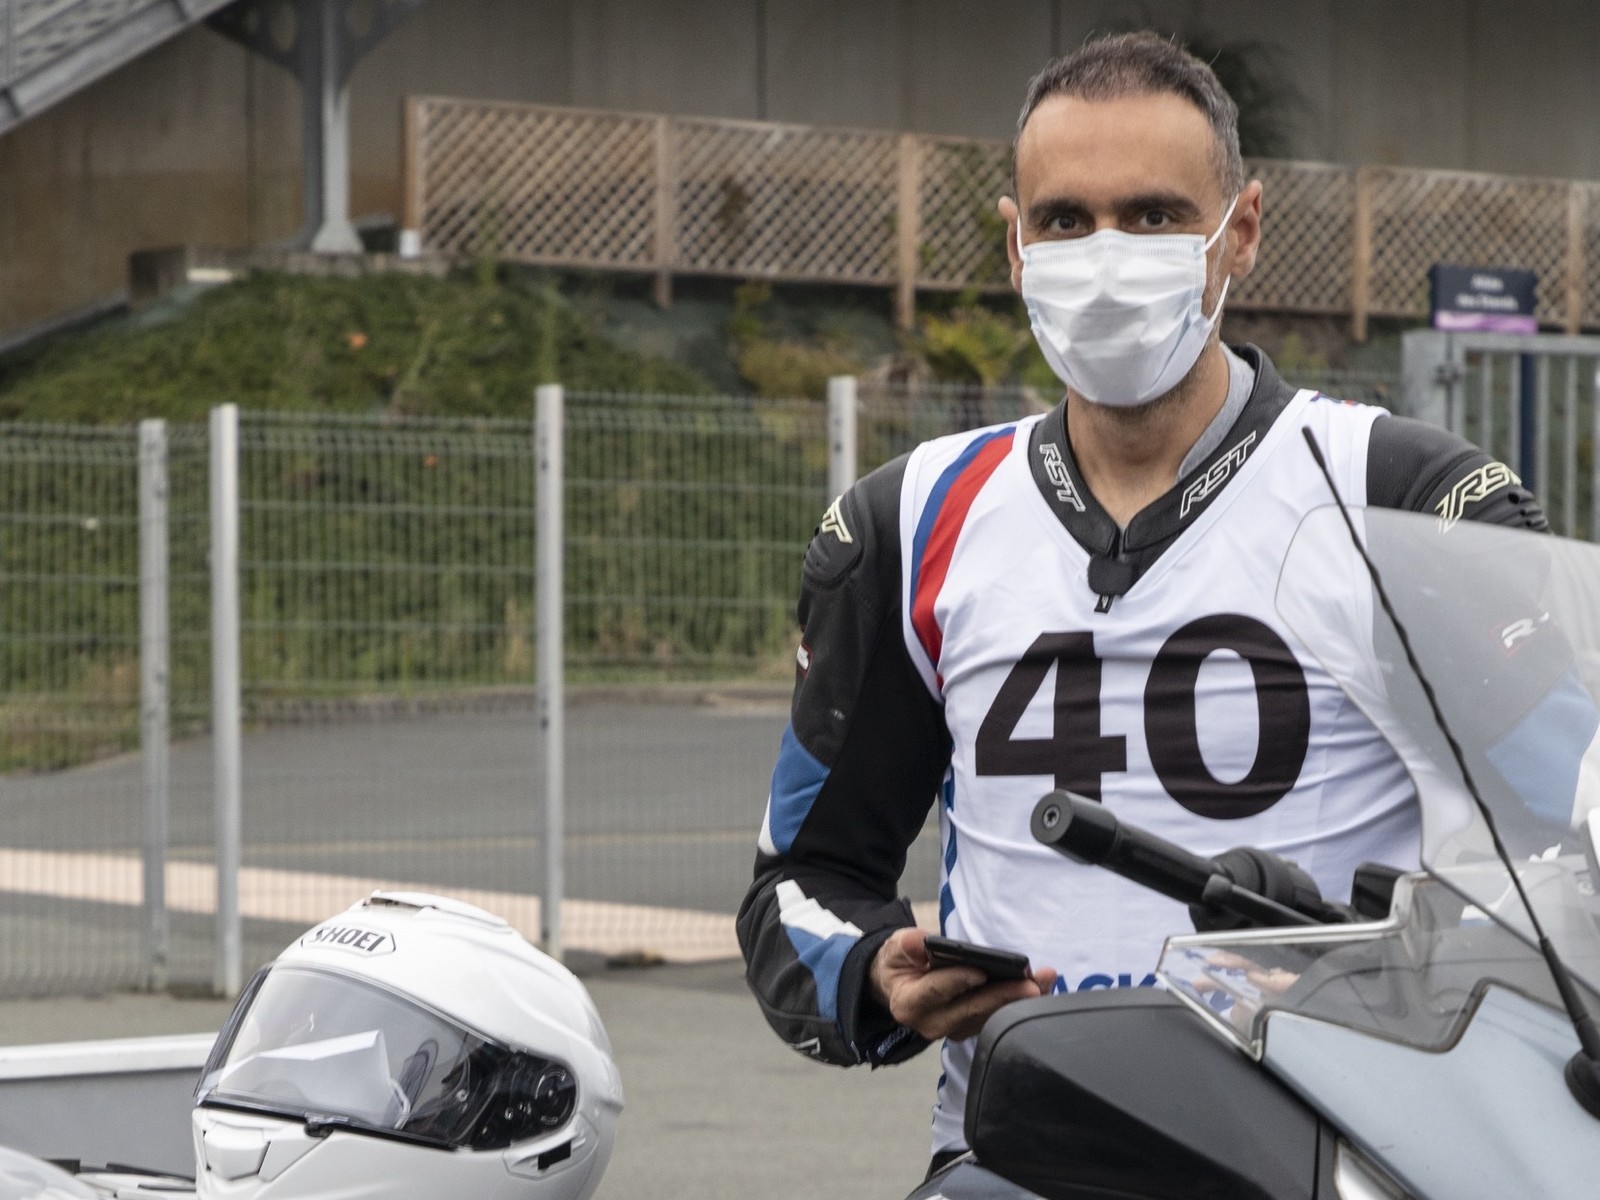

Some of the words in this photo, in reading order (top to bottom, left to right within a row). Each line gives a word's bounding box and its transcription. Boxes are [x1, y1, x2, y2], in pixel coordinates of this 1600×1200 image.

[1039, 442, 1086, 513] RST
[1180, 430, 1256, 519] RST
[975, 613, 1311, 820] 40
[310, 926, 386, 952] SHOEI
